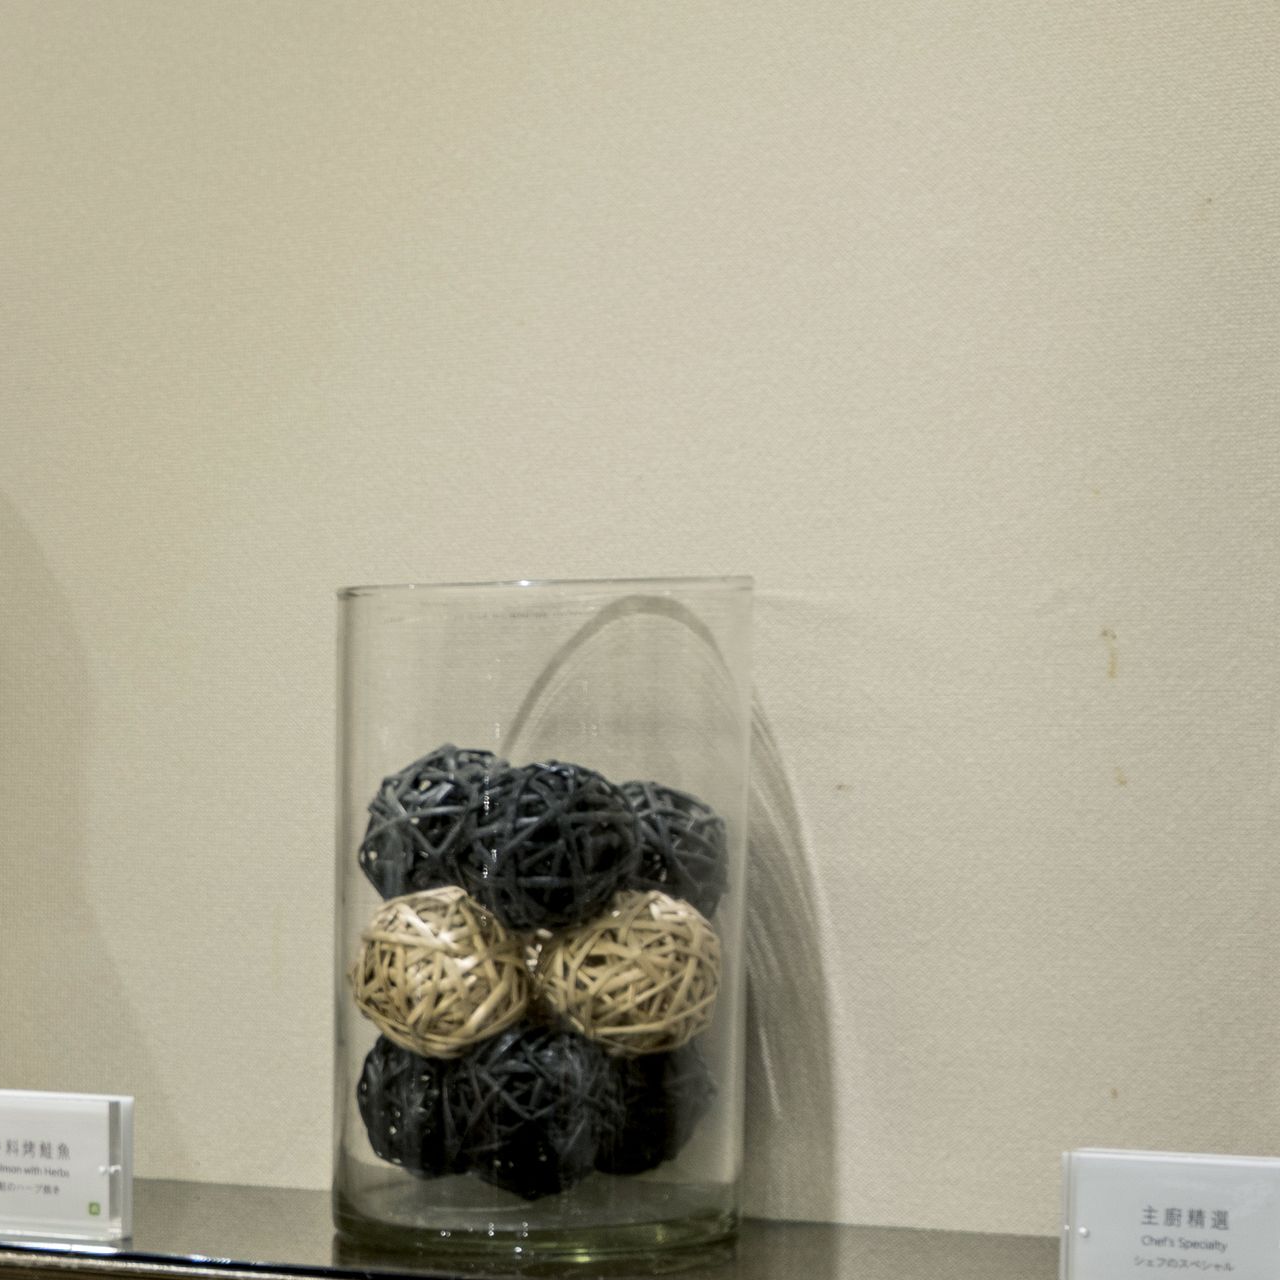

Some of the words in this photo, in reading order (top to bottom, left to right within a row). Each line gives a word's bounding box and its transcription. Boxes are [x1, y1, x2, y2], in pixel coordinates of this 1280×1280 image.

[23, 1165, 42, 1176] with
[44, 1166, 70, 1179] Herbs
[1140, 1205, 1230, 1231] 主廚精選
[1140, 1235, 1175, 1249] Chef's
[1178, 1237, 1228, 1253] Specialty
